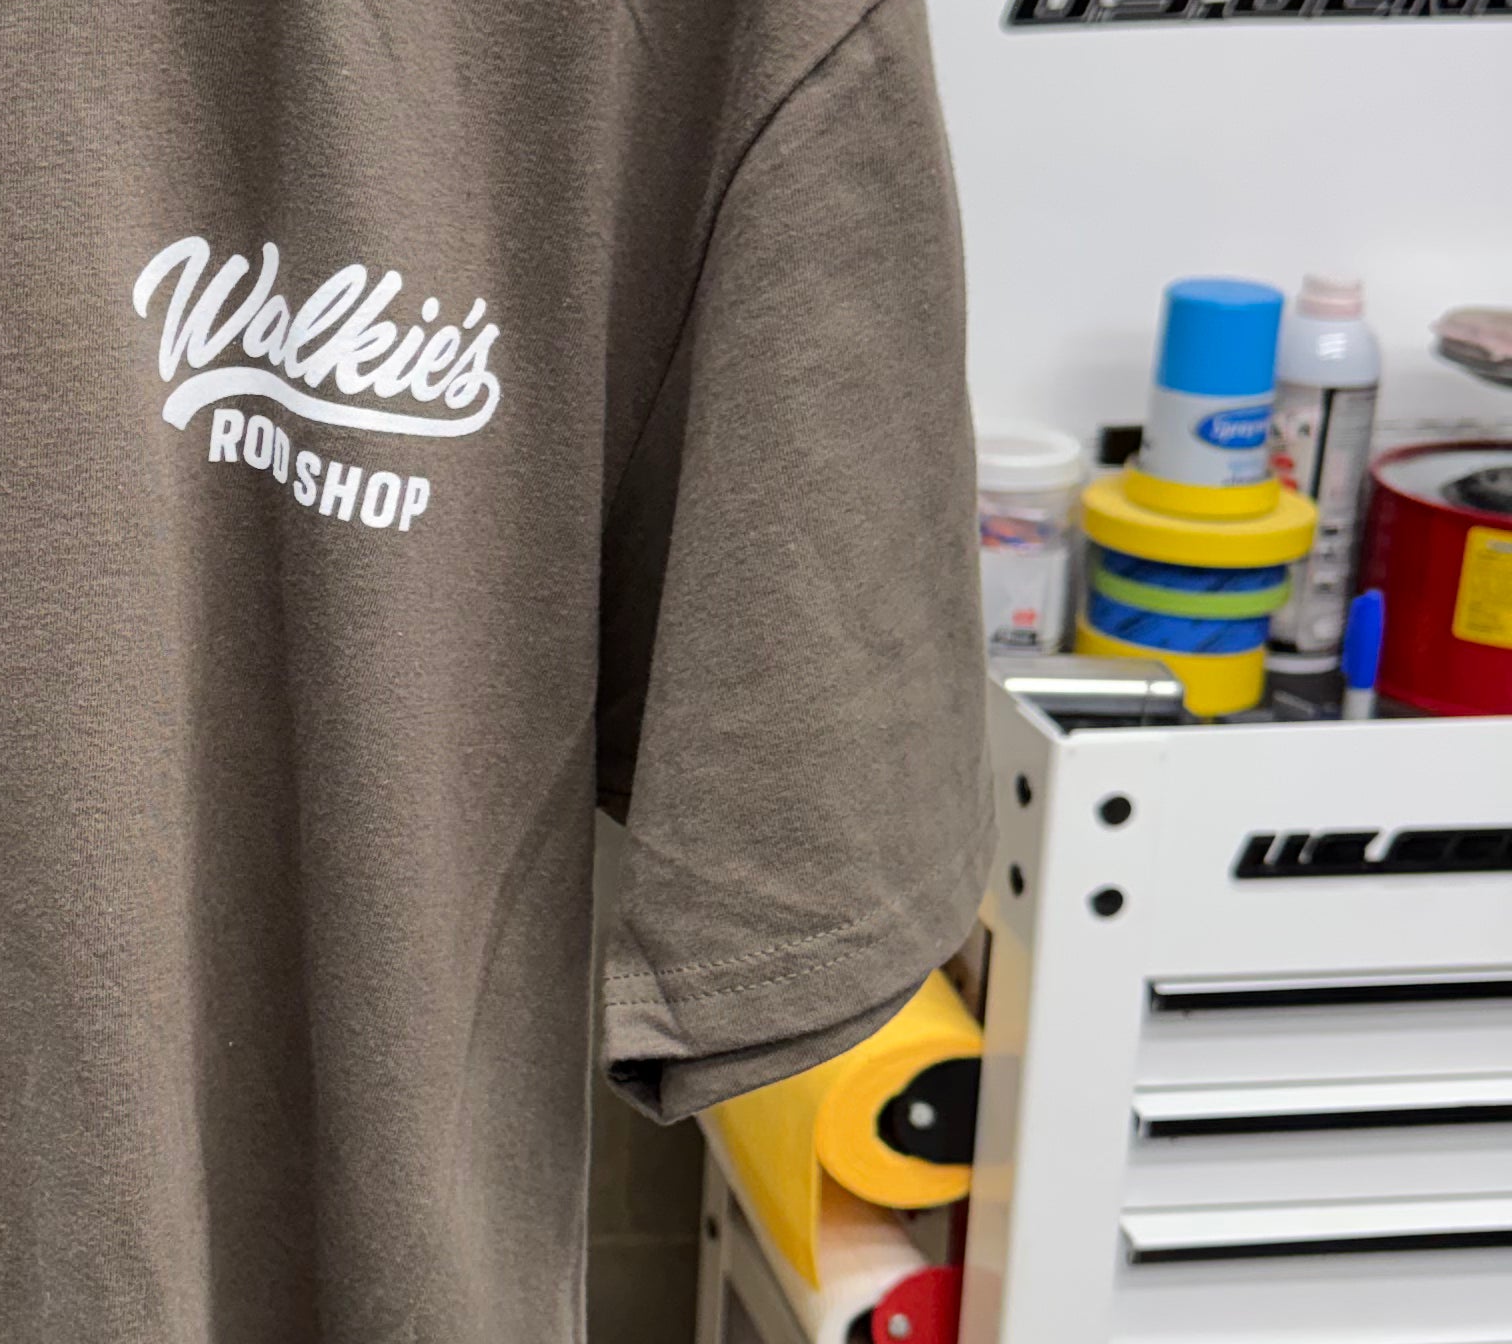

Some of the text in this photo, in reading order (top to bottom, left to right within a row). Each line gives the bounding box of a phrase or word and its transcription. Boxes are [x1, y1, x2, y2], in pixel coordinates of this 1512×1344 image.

[133, 235, 501, 411] Walkie's
[208, 408, 430, 532] ROD SHOP
